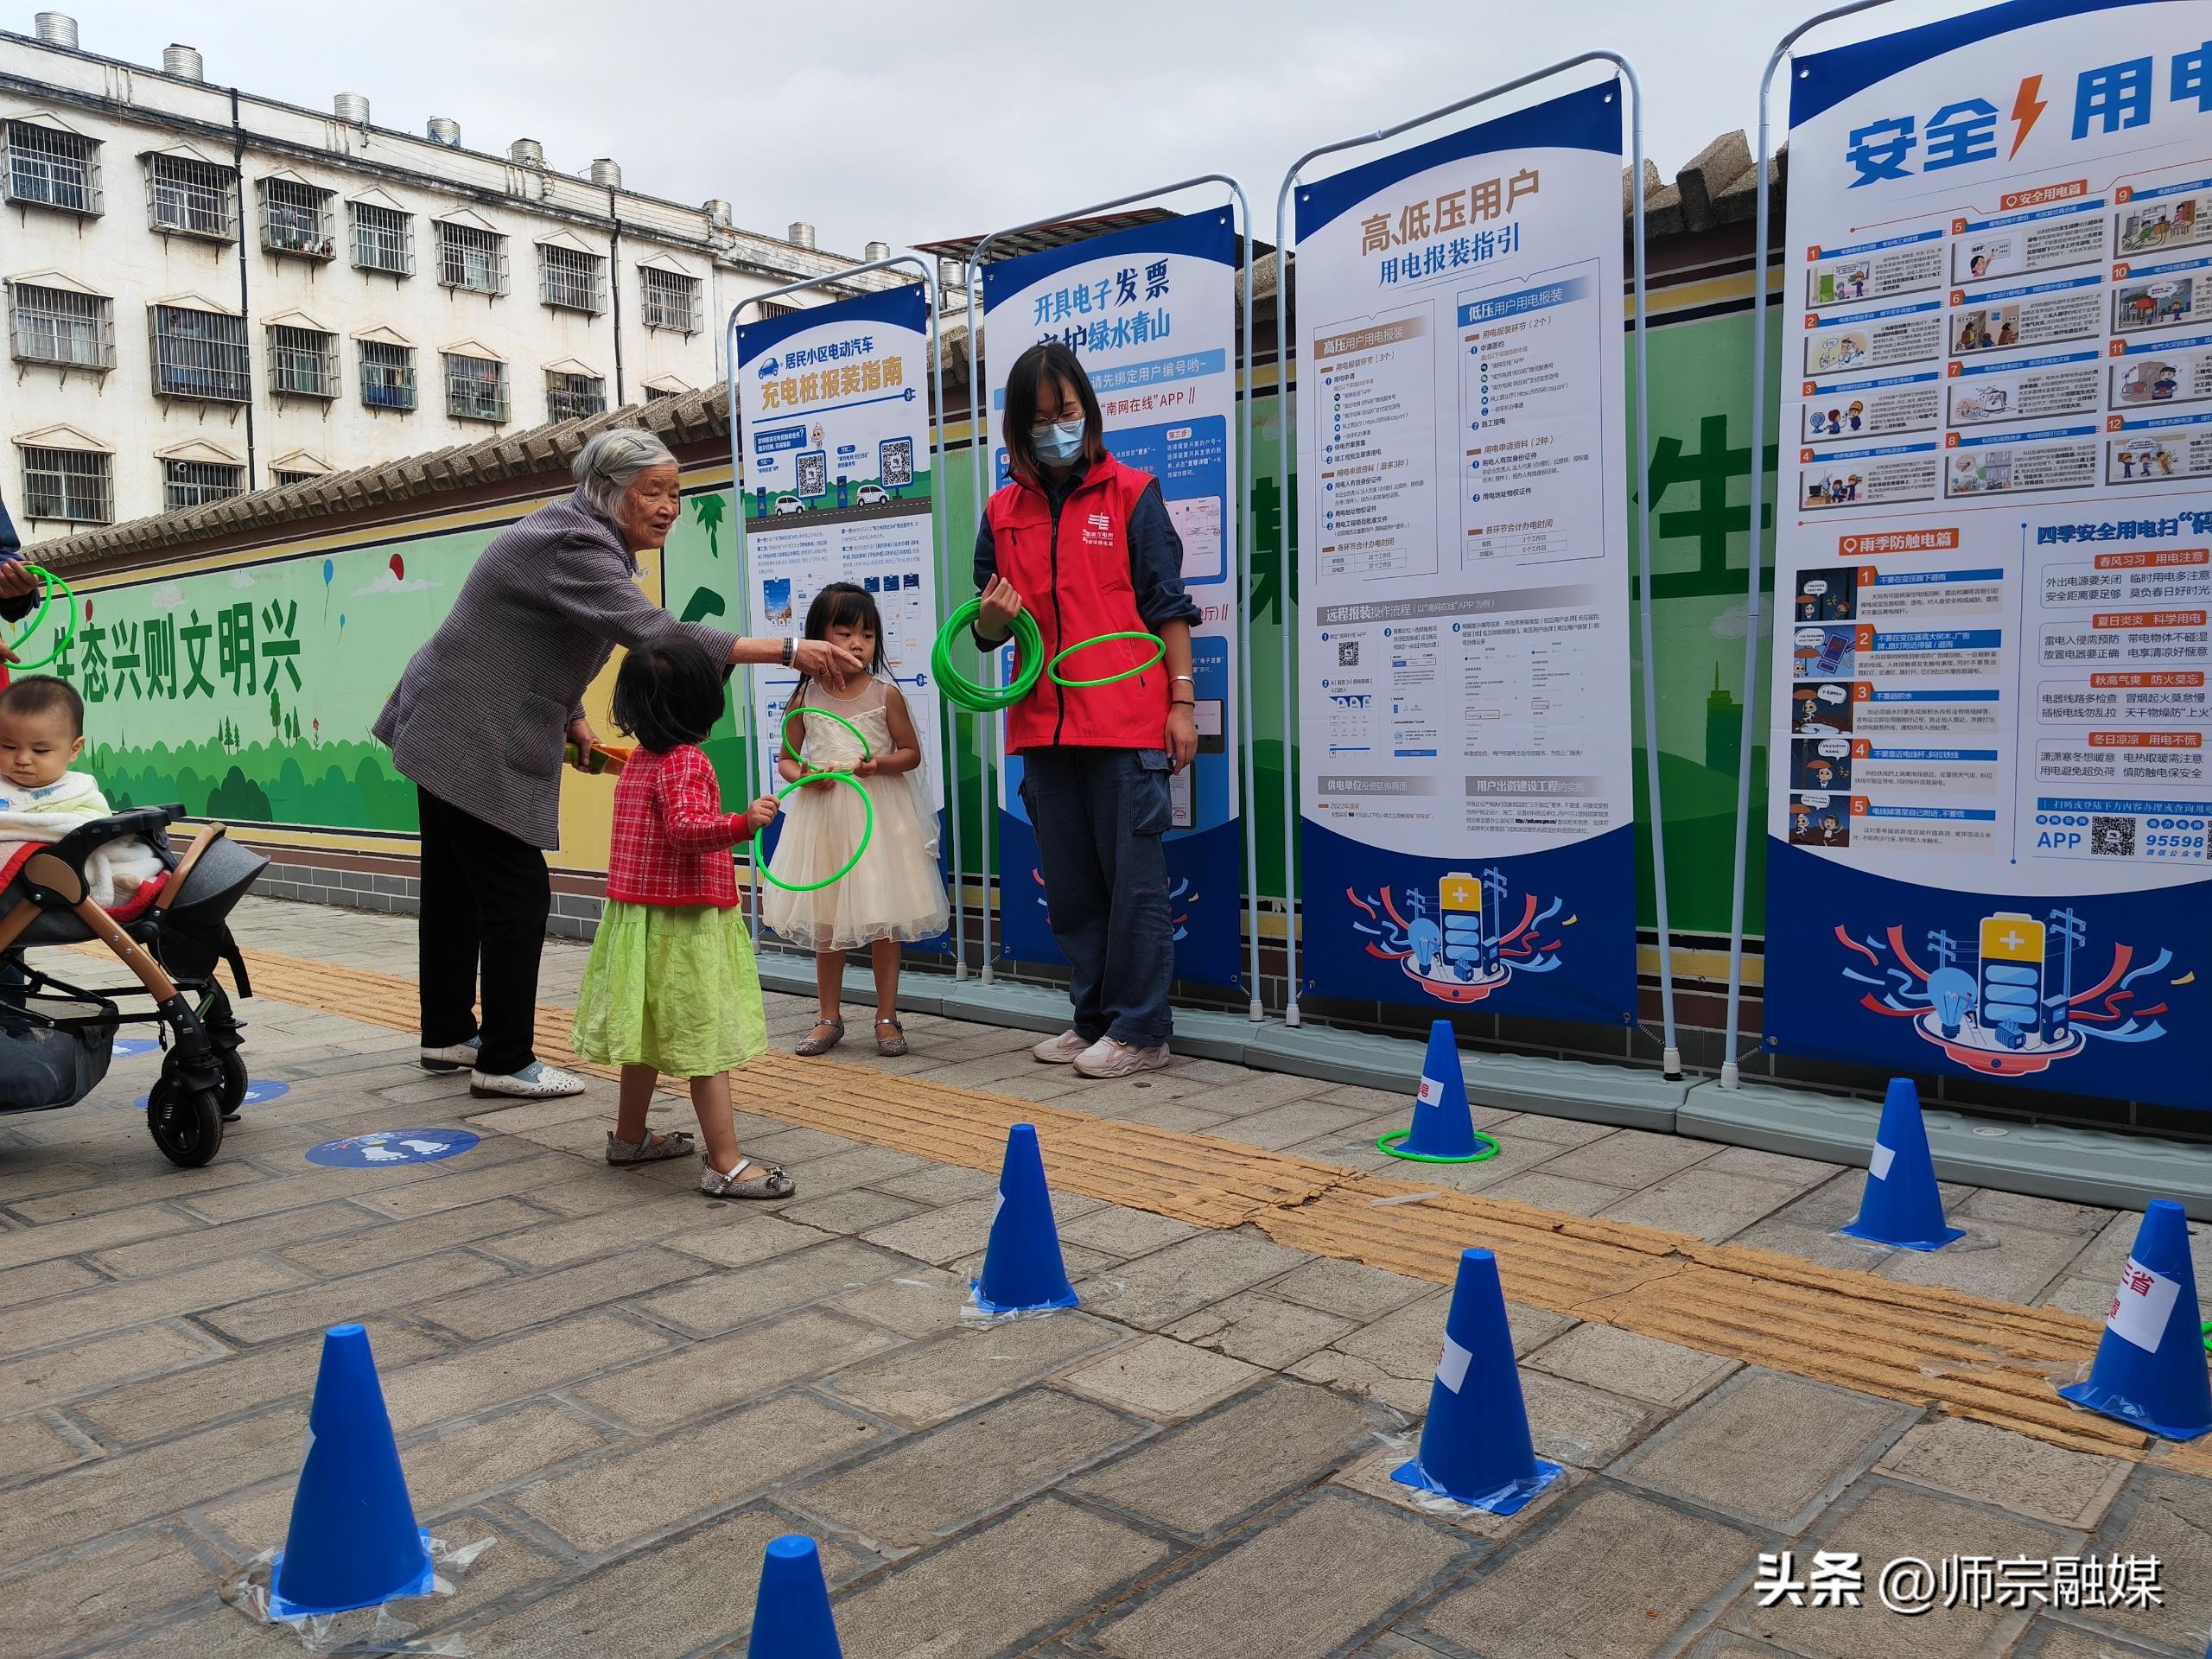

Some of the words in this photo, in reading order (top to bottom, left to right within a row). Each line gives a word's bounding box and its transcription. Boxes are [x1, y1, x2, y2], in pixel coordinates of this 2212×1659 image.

[1846, 98, 2000, 189] 安全
[2018, 183, 2082, 206] 安全用电篇
[2118, 189, 2127, 201] 9
[1360, 168, 1540, 256] 高、低压用户
[1378, 222, 1519, 288] 用电报装指引
[2113, 267, 2126, 278] 10
[1033, 258, 1170, 327] 开具电子发票
[1468, 288, 1563, 322] 低压用户用电报装
[1324, 326, 1404, 355] 高压用户用电报装
[1480, 340, 1505, 352] 申请签约
[785, 336, 874, 370] 居民小区电动汽车
[2112, 343, 2123, 354] 11
[760, 355, 904, 410] 充电桩报装指南
[1333, 372, 1355, 383] 用电申请
[1481, 417, 1506, 429] 施工接电
[2107, 419, 2121, 429] 12
[1334, 439, 1366, 451] 供电方案答复
[1334, 448, 1382, 462] 竣工检验及装表接电
[1482, 452, 1538, 467] 用电人有效身份证件
[1334, 476, 1382, 489] 用电人有效身份证件
[1482, 487, 1532, 500] 用电地址物权证件
[1335, 505, 1377, 518] 用电地址物权证件
[1335, 516, 1388, 529] 用电工程项目批准文件
[1485, 518, 1554, 535] 各环节合计办电时间
[1337, 537, 1395, 552] 各环节合计办电时间
[1859, 531, 1952, 552] 雨季防触电篇
[2100, 555, 2145, 568] 春风习习
[2155, 551, 2204, 564] 用电注意
[1861, 570, 1869, 583] 1
[1879, 573, 1946, 584] 不要在变压器下避雨
[2045, 574, 2122, 588] 外出电源要关闭
[2129, 570, 2211, 584] 临时用电多注意
[2045, 588, 2122, 602] 安全距离要足够
[2129, 585, 2211, 599] 莫负春日好时光
[2097, 615, 2144, 627] 夏日炎炎
[2152, 613, 2202, 625] 科学用电
[1859, 632, 1868, 645] 2
[2044, 634, 2120, 646] 雷电入侵需预防
[2127, 631, 2209, 644] 带电物体不碰湿
[2044, 649, 2120, 660] 放置电器要正确
[2127, 646, 2209, 658] 电享清凉好惬意
[2094, 675, 2141, 685] 秋高气爽
[2151, 674, 2200, 685] 防火莫忘
[1857, 686, 1867, 699] 3
[2042, 693, 2118, 704] 电器线路多检查
[2126, 692, 2206, 703] 冒烟起火莫怠慢
[2042, 708, 2117, 718] 插板电线勿乱拉
[2093, 734, 2139, 745] 冬日凉凉
[2148, 734, 2196, 746] 用电不慌
[1855, 744, 1866, 756] 4
[2040, 752, 2115, 762] 潇潇寒冬想暖意
[2123, 753, 2203, 765] 电热取暖需注意
[2040, 766, 2115, 777] 用电避免超负荷
[2123, 767, 2203, 779] 慎防触电保安全
[1327, 780, 1408, 791] 供电单位投资延伸界面
[1476, 780, 1586, 792] 用户出资建设工程的实施
[1853, 800, 1864, 812] 5
[2037, 831, 2082, 849] APP
[2145, 835, 2204, 849] 95598
[2145, 849, 2202, 858] 微信公众号
